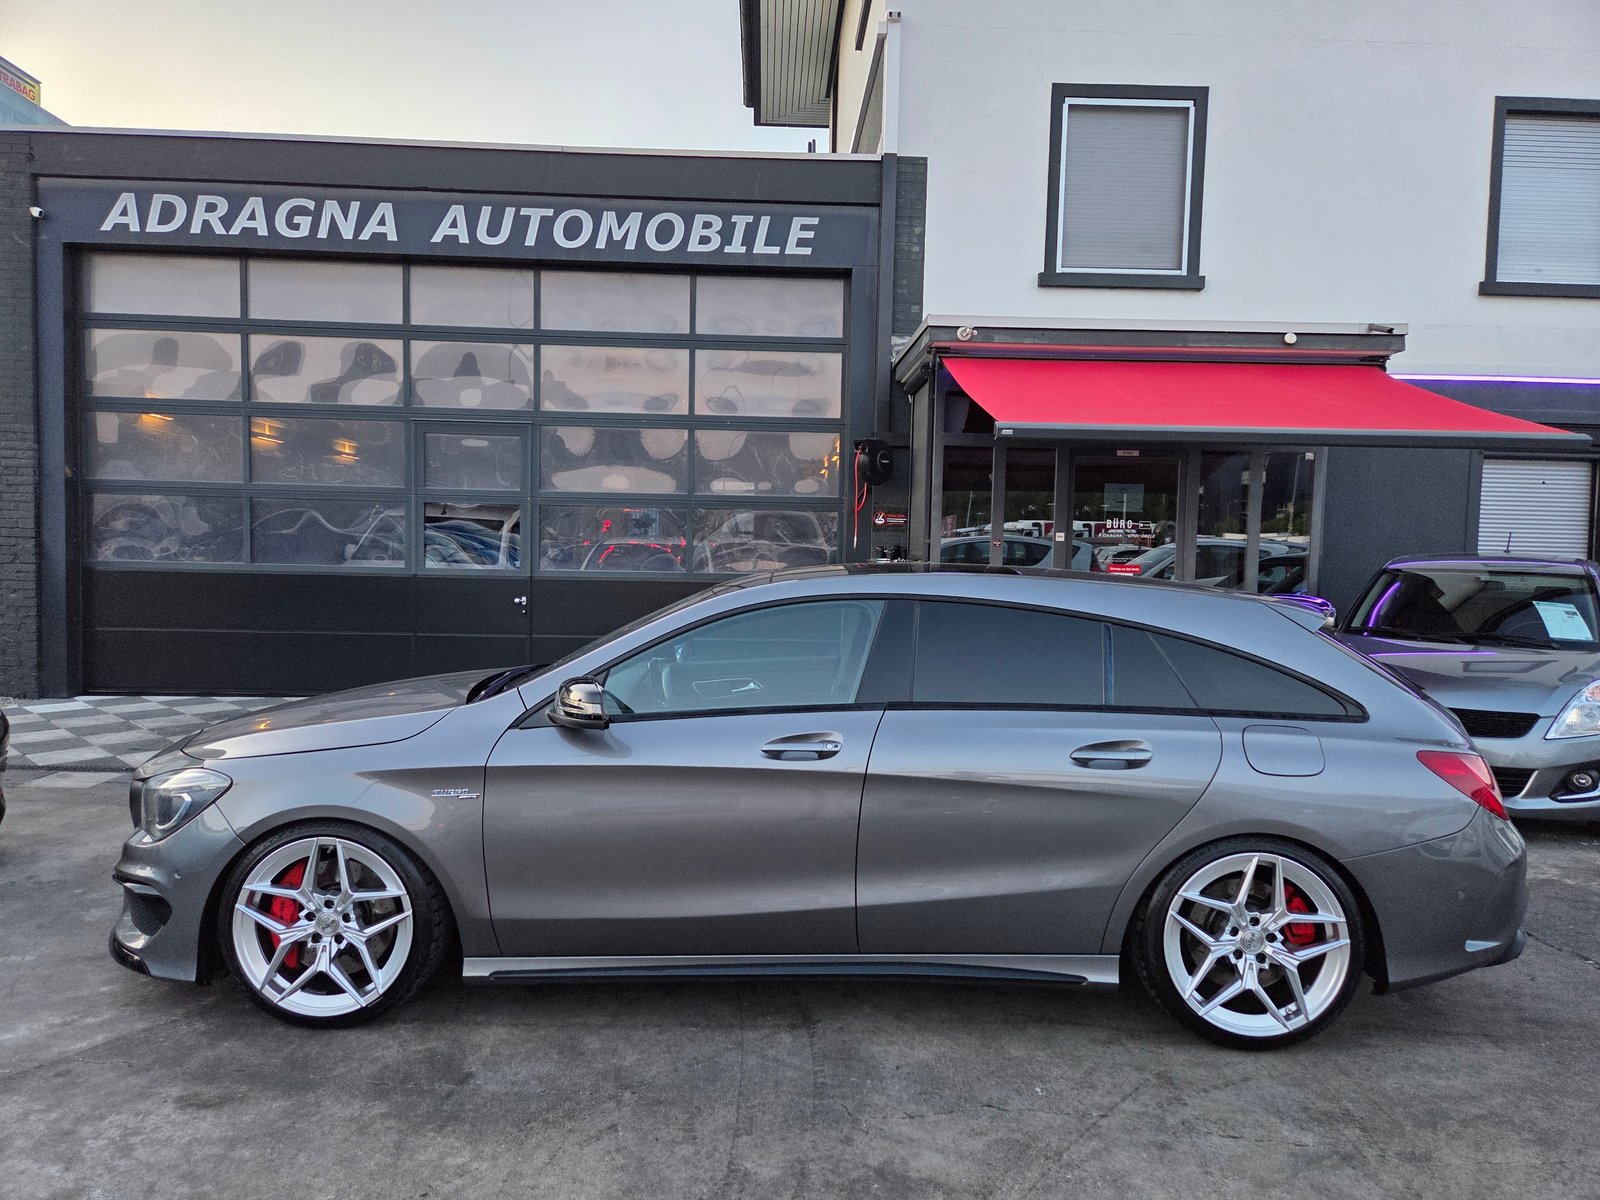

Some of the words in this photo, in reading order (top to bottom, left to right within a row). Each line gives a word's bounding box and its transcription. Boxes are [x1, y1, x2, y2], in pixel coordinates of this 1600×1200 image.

[100, 192, 398, 242] ADRAGNA
[430, 204, 820, 256] AUTOMOBILE
[1106, 518, 1133, 529] BÜRO
